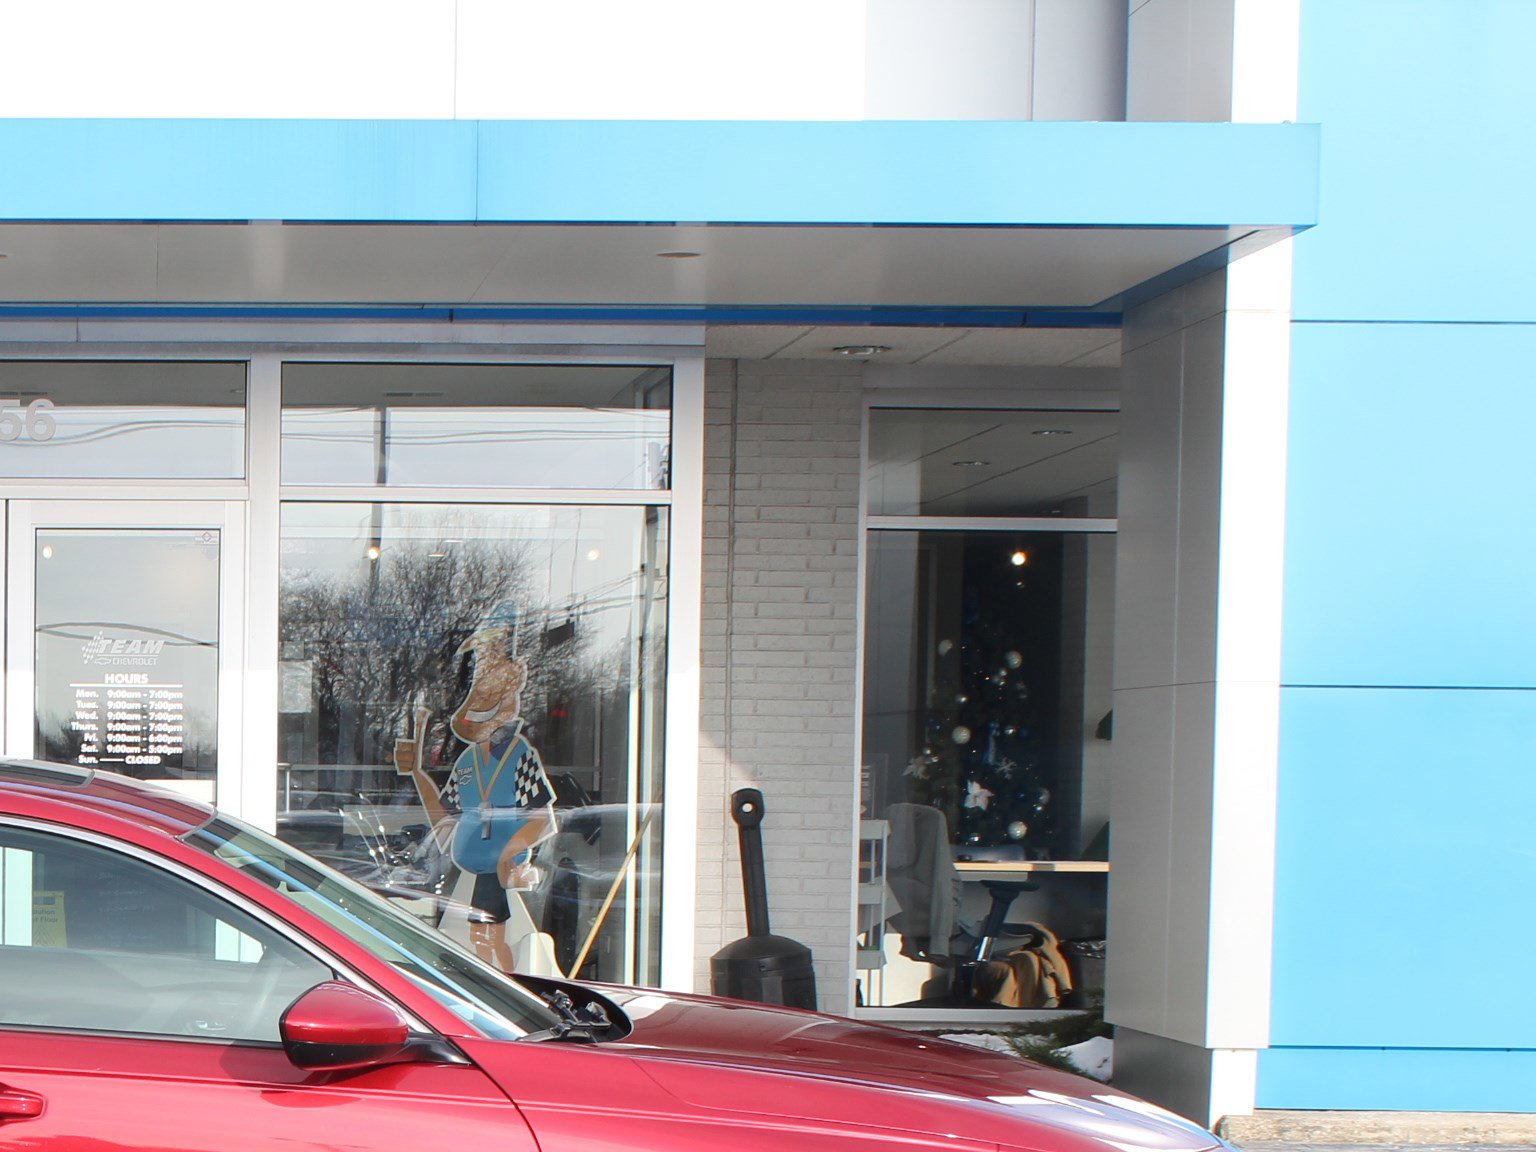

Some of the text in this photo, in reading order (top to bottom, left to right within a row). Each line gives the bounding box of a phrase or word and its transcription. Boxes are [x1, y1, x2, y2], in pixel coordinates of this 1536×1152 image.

[98, 639, 165, 654] TEAM
[112, 657, 158, 666] CHEVROLET
[104, 673, 149, 684] HOURS
[78, 754, 161, 764] Sun. CLOSED
